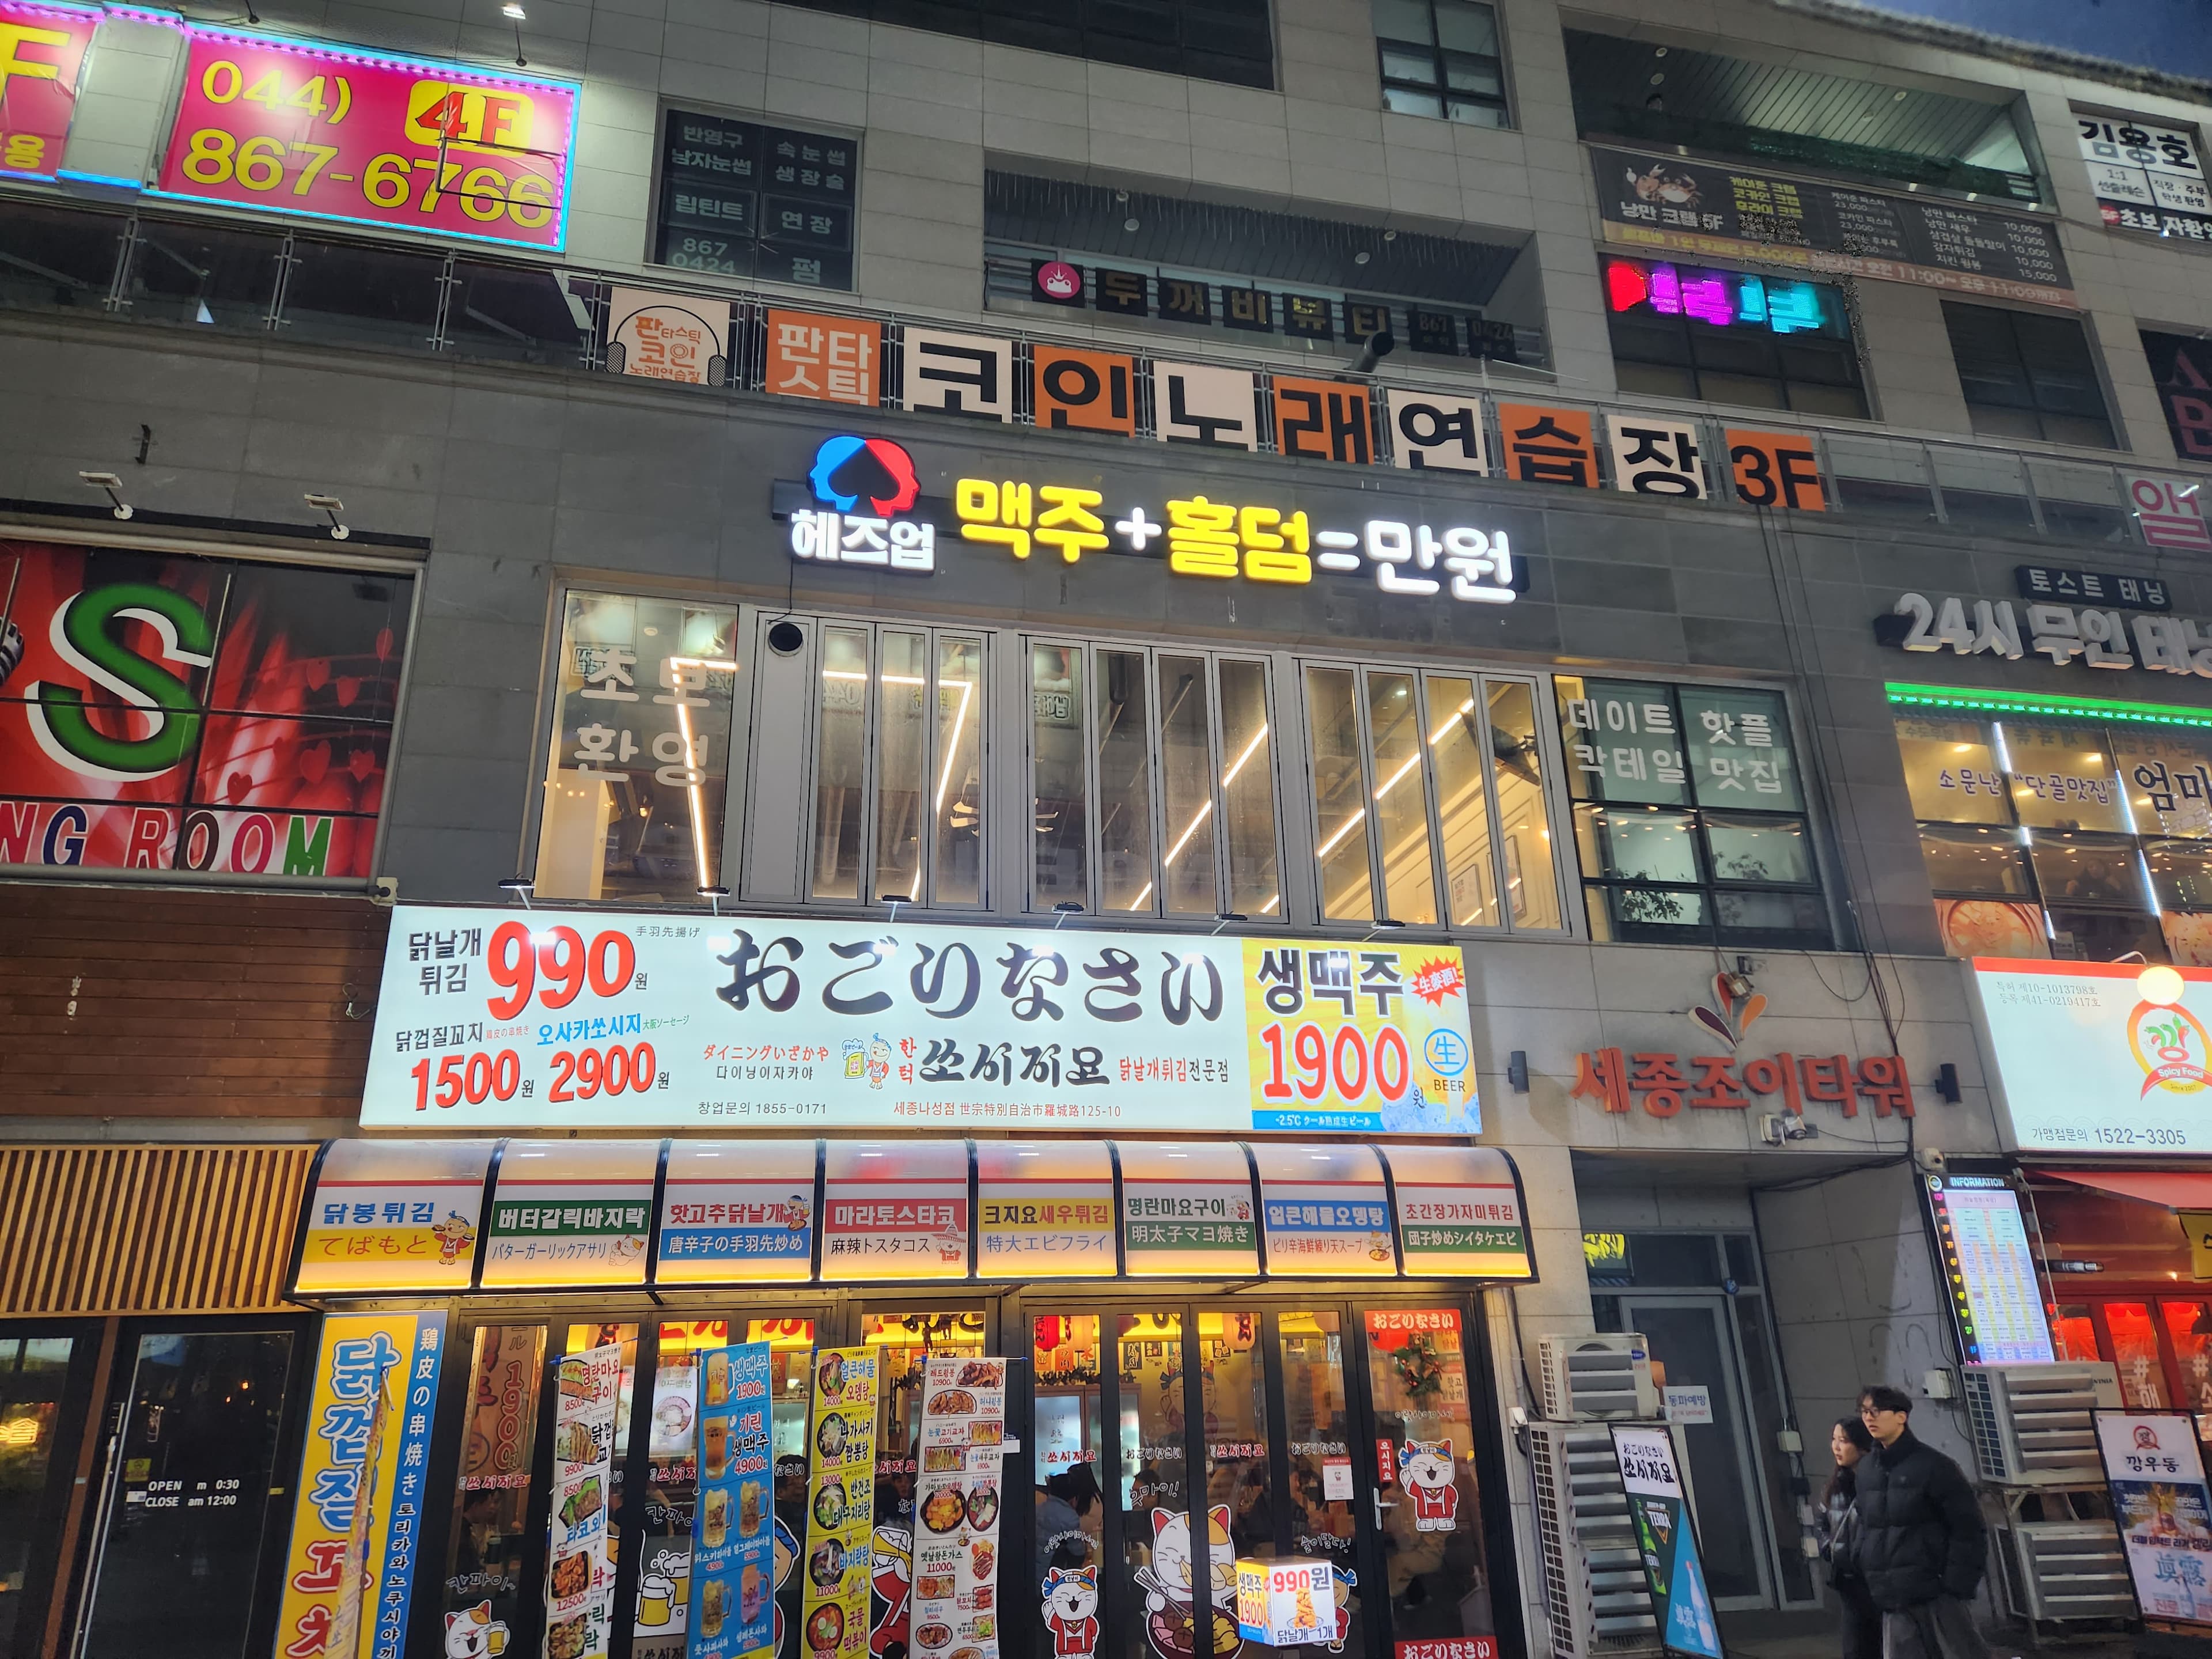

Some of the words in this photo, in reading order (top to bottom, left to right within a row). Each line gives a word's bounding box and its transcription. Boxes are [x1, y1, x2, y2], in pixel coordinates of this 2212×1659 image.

[202, 60, 353, 125] 044)
[415, 90, 521, 144] 4F
[683, 125, 744, 149] 반영구
[2078, 120, 2198, 171] 김용호
[671, 147, 752, 176] 남자눈썹
[181, 128, 553, 229] 867-6766
[781, 210, 833, 234] 연장
[1620, 201, 1657, 221] 낭만
[2004, 222, 2042, 235] 10,000
[2008, 233, 2046, 246] 10,000
[683, 237, 728, 257] 867
[2010, 244, 2050, 259] 10,000
[672, 253, 736, 275] 0424
[791, 257, 822, 285] 펌
[2015, 256, 2054, 270] 10,000
[2018, 268, 2057, 282] 15,000
[637, 342, 696, 369] 코인
[778, 324, 872, 370] 판타
[777, 366, 869, 405] 스틱
[1730, 445, 1820, 509] 3F
[790, 509, 937, 571] 헤즈업
[2028, 567, 2105, 598] 토스트
[2119, 578, 2166, 605] 태닝
[1893, 592, 2024, 660] 24시
[2026, 603, 2134, 669] 무인
[25, 581, 218, 782] S
[1566, 698, 1676, 734] 데이트
[1700, 709, 1774, 747] 핫플
[574, 722, 709, 787] 환영
[1573, 744, 1686, 784] 칵테일
[1709, 757, 1783, 794] 맛집
[1938, 768, 2002, 798] 소문난
[123, 806, 334, 876] ROOM
[635, 925, 701, 939] 手羽先揚げ
[408, 927, 482, 961] 닭날개
[418, 963, 468, 996] 튀김
[716, 928, 1224, 1027] おごりなさい
[1257, 948, 1404, 1018] 생맥주
[395, 1021, 484, 1053] 닭껍질꼬치
[536, 1012, 642, 1046] 오사카쏘시지
[642, 1014, 690, 1031] 大阪ソーセージ
[703, 1043, 830, 1062] ダイニングいざかや
[1434, 1035, 1460, 1066] 生
[716, 1064, 813, 1081] 다이닝이자카야
[918, 1037, 1111, 1088] 쏘시지요
[1119, 1055, 1229, 1085] 닭날개튀김전문점
[2157, 1066, 2180, 1079] Spicy
[2181, 1066, 2205, 1080] Food
[1434, 1078, 1466, 1093] BEER
[1570, 1047, 1916, 1118] 세종조이타워
[698, 1101, 751, 1115] 창업문의
[755, 1103, 827, 1115] 1855-0171
[893, 1101, 956, 1116] 세종나성점
[2031, 1127, 2089, 1143] 가맹점문의
[2094, 1127, 2187, 1146] 1522-3305
[1948, 1176, 2006, 1188] INFORMATION
[323, 1202, 435, 1225] 닭봉튀김
[498, 1207, 647, 1230] 버터갈릭바지락
[670, 1203, 785, 1225] 핫고추닭날개
[835, 1205, 956, 1226] 마라토스타코
[983, 1205, 1109, 1225] 크지요새우튀김
[1127, 1197, 1226, 1217] 명란마요구이
[1268, 1206, 1384, 1227] 얼큰해물오뎅탕
[1406, 1203, 1514, 1221] 초간장가자미튀김
[319, 1235, 428, 1256] てばもと
[668, 1234, 803, 1255] 唐辛子の手羽先炒め
[831, 1237, 930, 1255] 麻辣トスタコス
[986, 1234, 1107, 1253] 特大エビフライ
[1131, 1225, 1249, 1244] 明太子マヨ焼き
[1373, 1313, 1455, 1330] おごりなさい
[734, 1355, 768, 1381] 생맥주
[840, 1358, 876, 1384] 얼큰해물
[846, 1380, 870, 1403] 오뎅탕
[1668, 1394, 1707, 1407] 동파예방
[738, 1412, 763, 1434] 기린
[840, 1417, 873, 1441] 나가사키
[733, 1432, 770, 1458] 생맥주
[844, 1440, 869, 1464] 짬뽕탕
[1047, 1449, 1097, 1464] 쏘시지요
[1217, 1444, 1266, 1458] 쏘시지요
[2126, 1455, 2180, 1474] 깡우동
[148, 1480, 183, 1491] OPEN
[850, 1478, 872, 1499] 반건조
[145, 1496, 179, 1508] CLOSE
[187, 1498, 204, 1506] am
[206, 1495, 237, 1506] 12:00
[1647, 1510, 1672, 1530] TERRA
[838, 1543, 870, 1572] 바지락탕
[1238, 1572, 1263, 1599] 생맥주
[1273, 1566, 1331, 1593] 990원
[847, 1607, 865, 1629] 국물
[1239, 1598, 1263, 1627] 1900
[843, 1626, 868, 1653] 떡볶이
[1277, 1625, 1309, 1643] 닭날개
